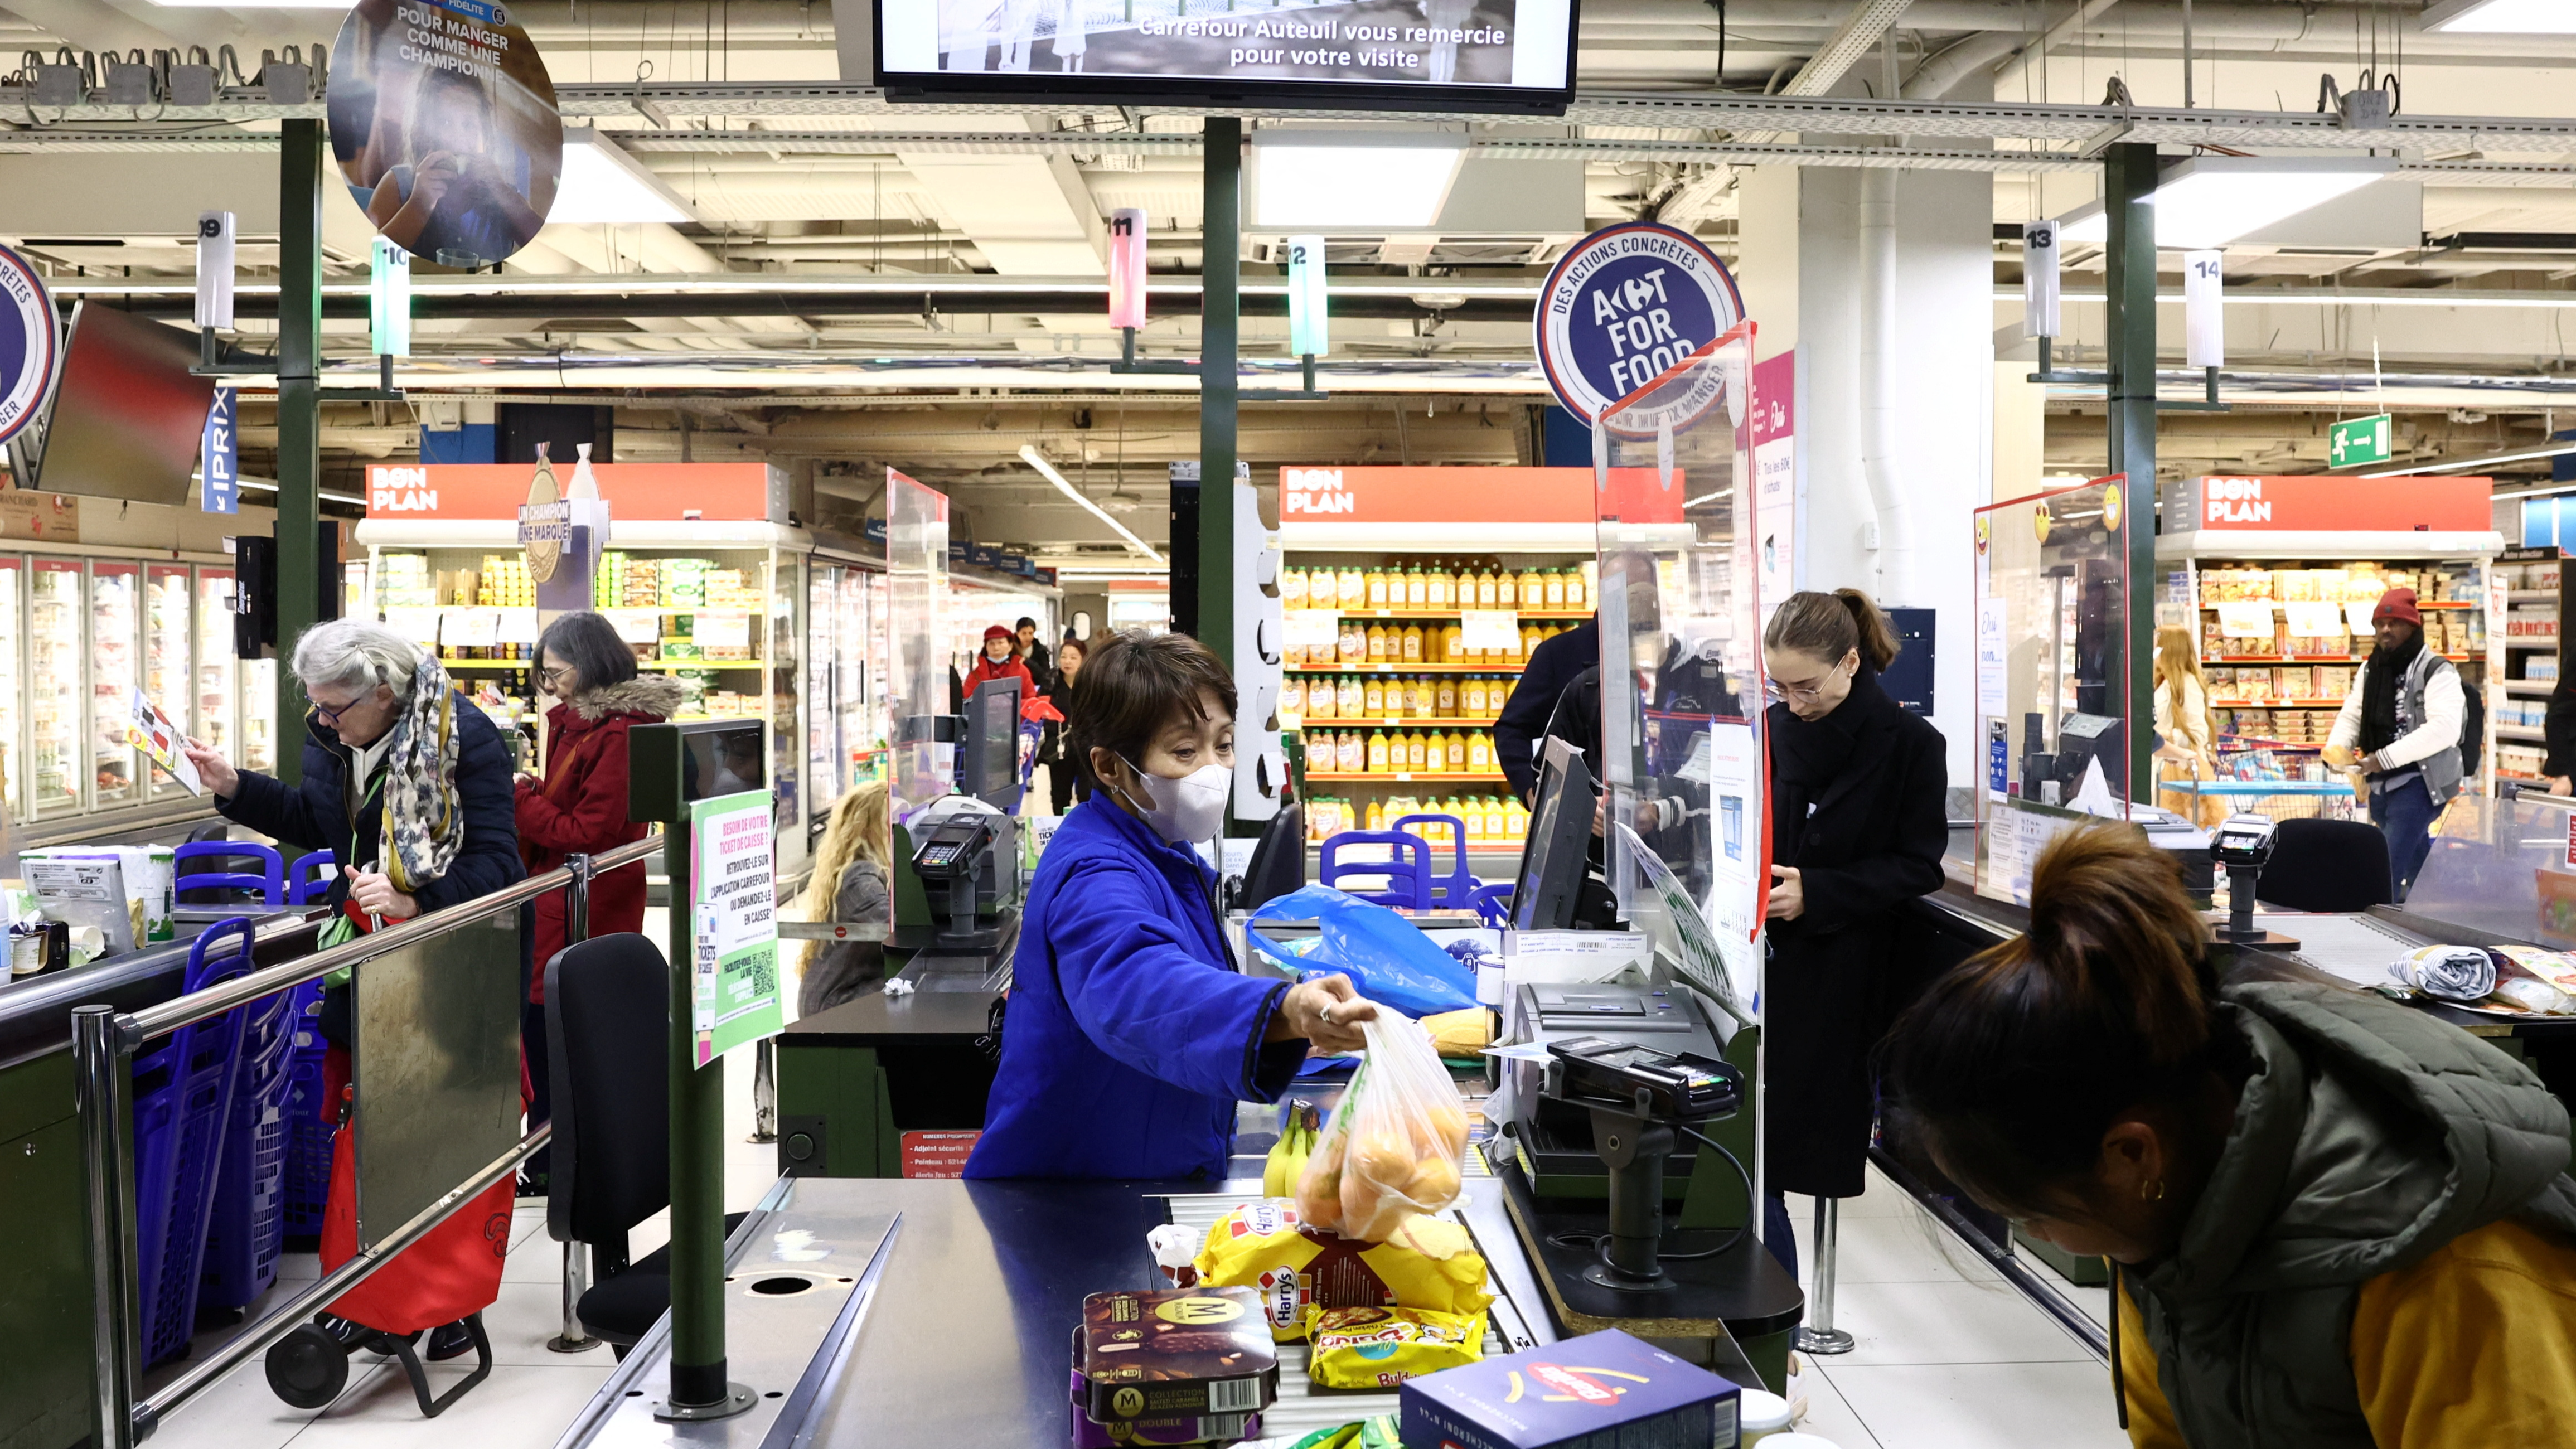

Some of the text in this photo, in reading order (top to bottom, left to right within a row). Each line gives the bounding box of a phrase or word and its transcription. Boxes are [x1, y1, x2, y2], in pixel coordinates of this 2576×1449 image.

[449, 0, 484, 16] FIDÉLITÉ
[397, 6, 509, 51] POUR MANGER
[1139, 17, 1505, 45] Carrefour Auteuil vous remercie
[407, 28, 501, 66] COMME UNE
[1231, 46, 1419, 68] pour votre visite
[1112, 217, 1132, 236] 11
[2026, 230, 2052, 249] 13
[382, 247, 407, 265] 10
[1553, 237, 1699, 314] DES ACTIONS CONCRÈTES
[2195, 261, 2220, 278] 14
[1607, 307, 1678, 358] FOR
[1610, 339, 1696, 396] FOOD
[1770, 400, 1785, 433] Oui
[372, 468, 425, 489] BON
[1287, 469, 1342, 491] BON
[2208, 479, 2260, 500] BON
[373, 491, 437, 511] PLAN
[1287, 493, 1354, 513] PLAN
[2208, 501, 2270, 521] PLAN
[519, 502, 568, 522] UN CHAMPION
[519, 523, 568, 543] UNE MARQUE
[1982, 611, 1997, 634] Oui
[1982, 651, 1994, 662] non
[723, 815, 768, 836] BESOIN DE VOTRE
[720, 839, 736, 855] TICKET
[737, 837, 743, 851] DE
[744, 833, 764, 849] CAISSE
[727, 854, 769, 875] RETROUVEZ-LE SUR
[711, 872, 770, 899] L'APPLICATION CARREFOUR
[730, 890, 771, 912] OU DEMANDEZ-LE
[744, 913, 750, 925] EN
[698, 945, 716, 961] TICKETS
[724, 956, 752, 974] FACILITEZ-VOUS
[740, 969, 745, 979] LA
[1256, 1203, 1275, 1231] Harry
[1277, 1273, 1295, 1321] Harrys
[1187, 1302, 1227, 1318] M
[1376, 1369, 1420, 1388] Buld
[1120, 1393, 1136, 1407] M
[1149, 1389, 1205, 1399] COLLECTION
[1139, 1418, 1182, 1428] DOUBLE
